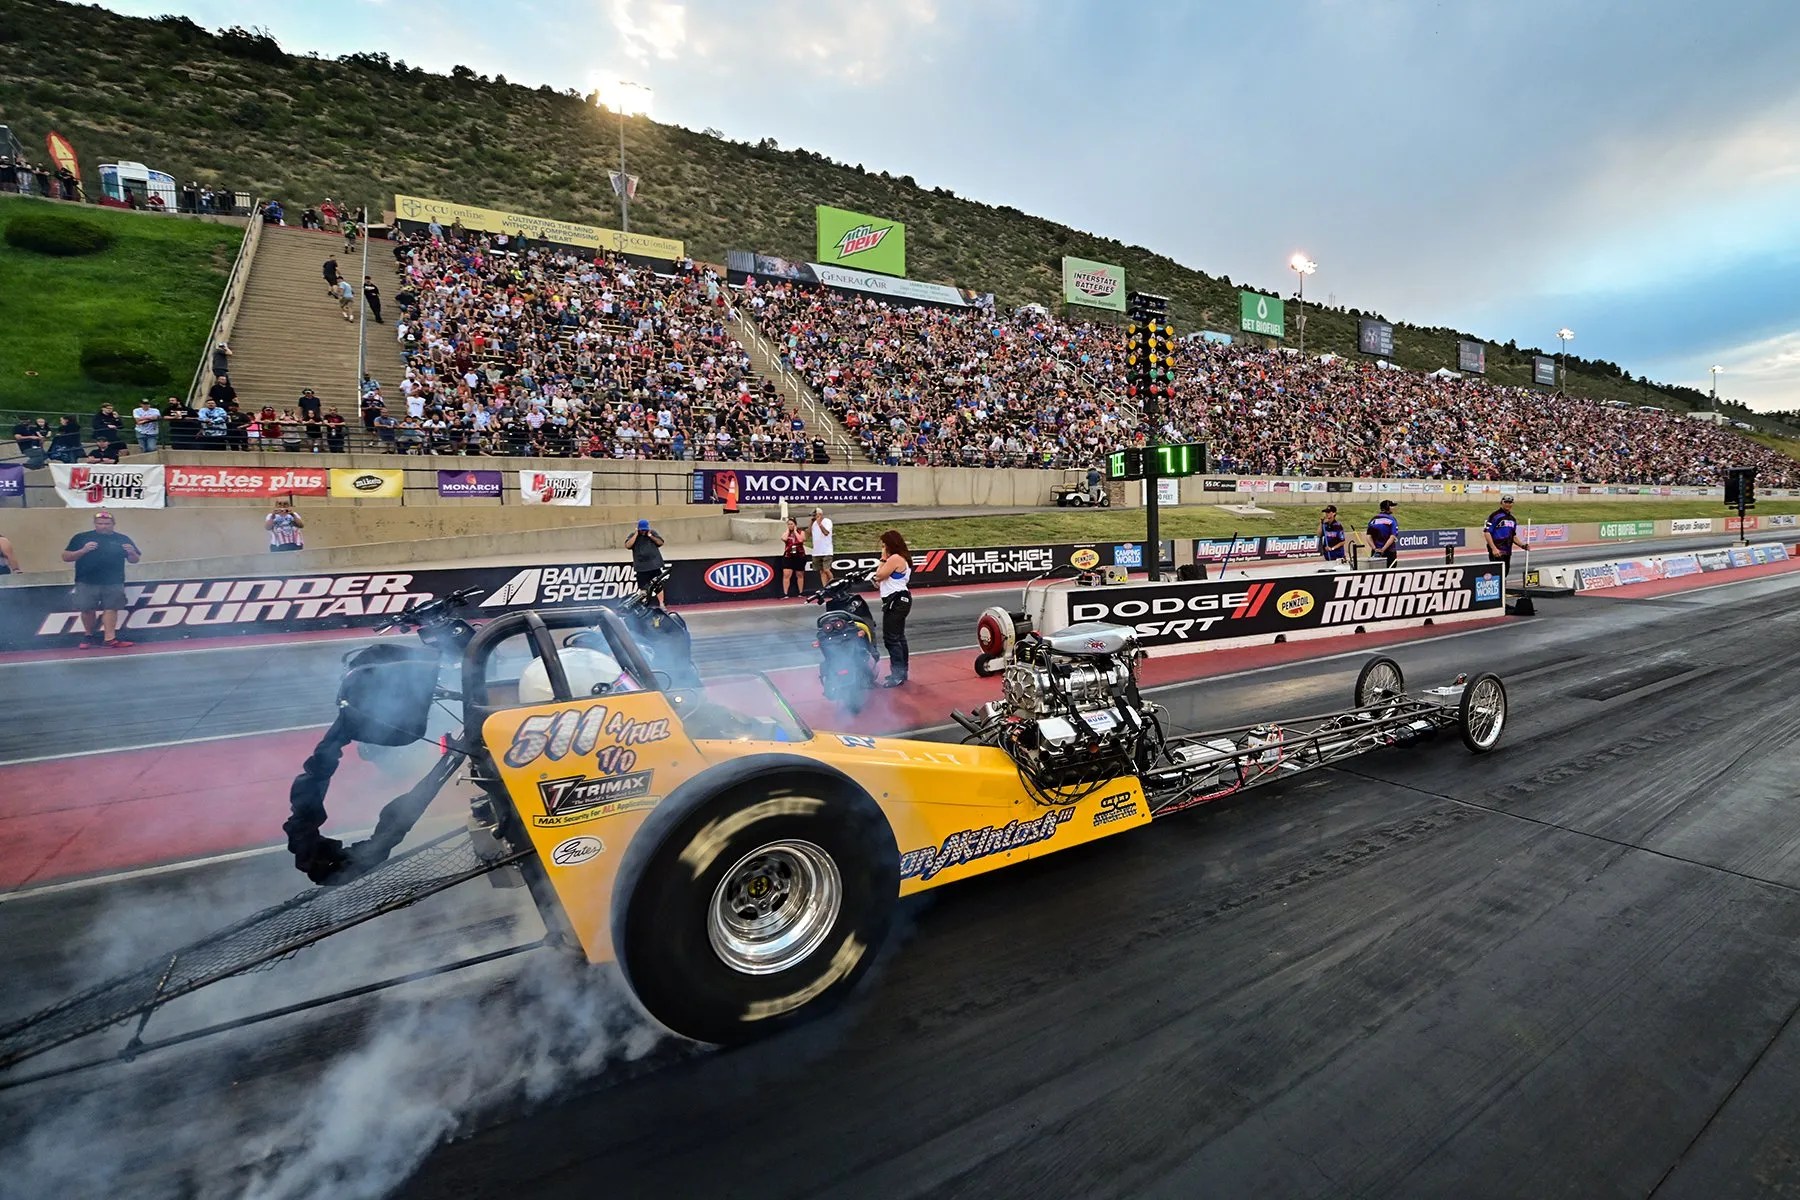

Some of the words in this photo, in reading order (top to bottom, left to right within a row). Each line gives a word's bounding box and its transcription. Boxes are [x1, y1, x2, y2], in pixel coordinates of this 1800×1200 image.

[424, 204, 448, 214] CCU
[454, 209, 484, 220] online
[502, 220, 538, 231] WITHOUT
[540, 226, 599, 240] COMPROMISING
[508, 216, 556, 228] CULTIVATING
[558, 222, 572, 230] THE
[574, 225, 594, 234] MIND
[551, 234, 572, 242] HEART
[630, 236, 650, 246] CCU
[652, 239, 677, 250] online
[1074, 272, 1117, 286] INTERSTATE
[1076, 281, 1114, 294] BATTERIES
[1243, 318, 1257, 331] GET
[1258, 321, 1282, 336] BIOFUEL
[70, 467, 144, 489] NITROUS
[170, 470, 262, 488] brakes
[268, 472, 322, 490] plus
[745, 476, 882, 492] MONARCH
[1607, 525, 1617, 536] GET
[1266, 537, 1318, 554] MagnaFuel
[1400, 534, 1428, 546] centura
[1074, 552, 1095, 564] PENNZOIL
[1114, 549, 1140, 557] CAMPING
[1114, 556, 1140, 564] WORLD
[713, 565, 768, 588] NHRA
[947, 559, 1053, 576] NATIONALS
[1580, 566, 1614, 578] BANDIMERE
[122, 574, 414, 606] HUNDER
[541, 580, 642, 604] SPEEDW
[1333, 568, 1465, 598] THUNDER
[1476, 586, 1500, 596] WORLD
[1072, 592, 1249, 621] DODGE
[1282, 596, 1309, 610] PENNZOIL
[1320, 588, 1472, 625] MOUNTAIN
[1135, 616, 1224, 639] SRT
[504, 705, 608, 768] 511
[605, 712, 670, 746] A/FUEL
[574, 776, 644, 798] TRIMAX
[564, 814, 590, 823] Security
[602, 804, 616, 814] ALL
[554, 840, 601, 865] Gates
[929, 811, 1057, 877] McIntosh
